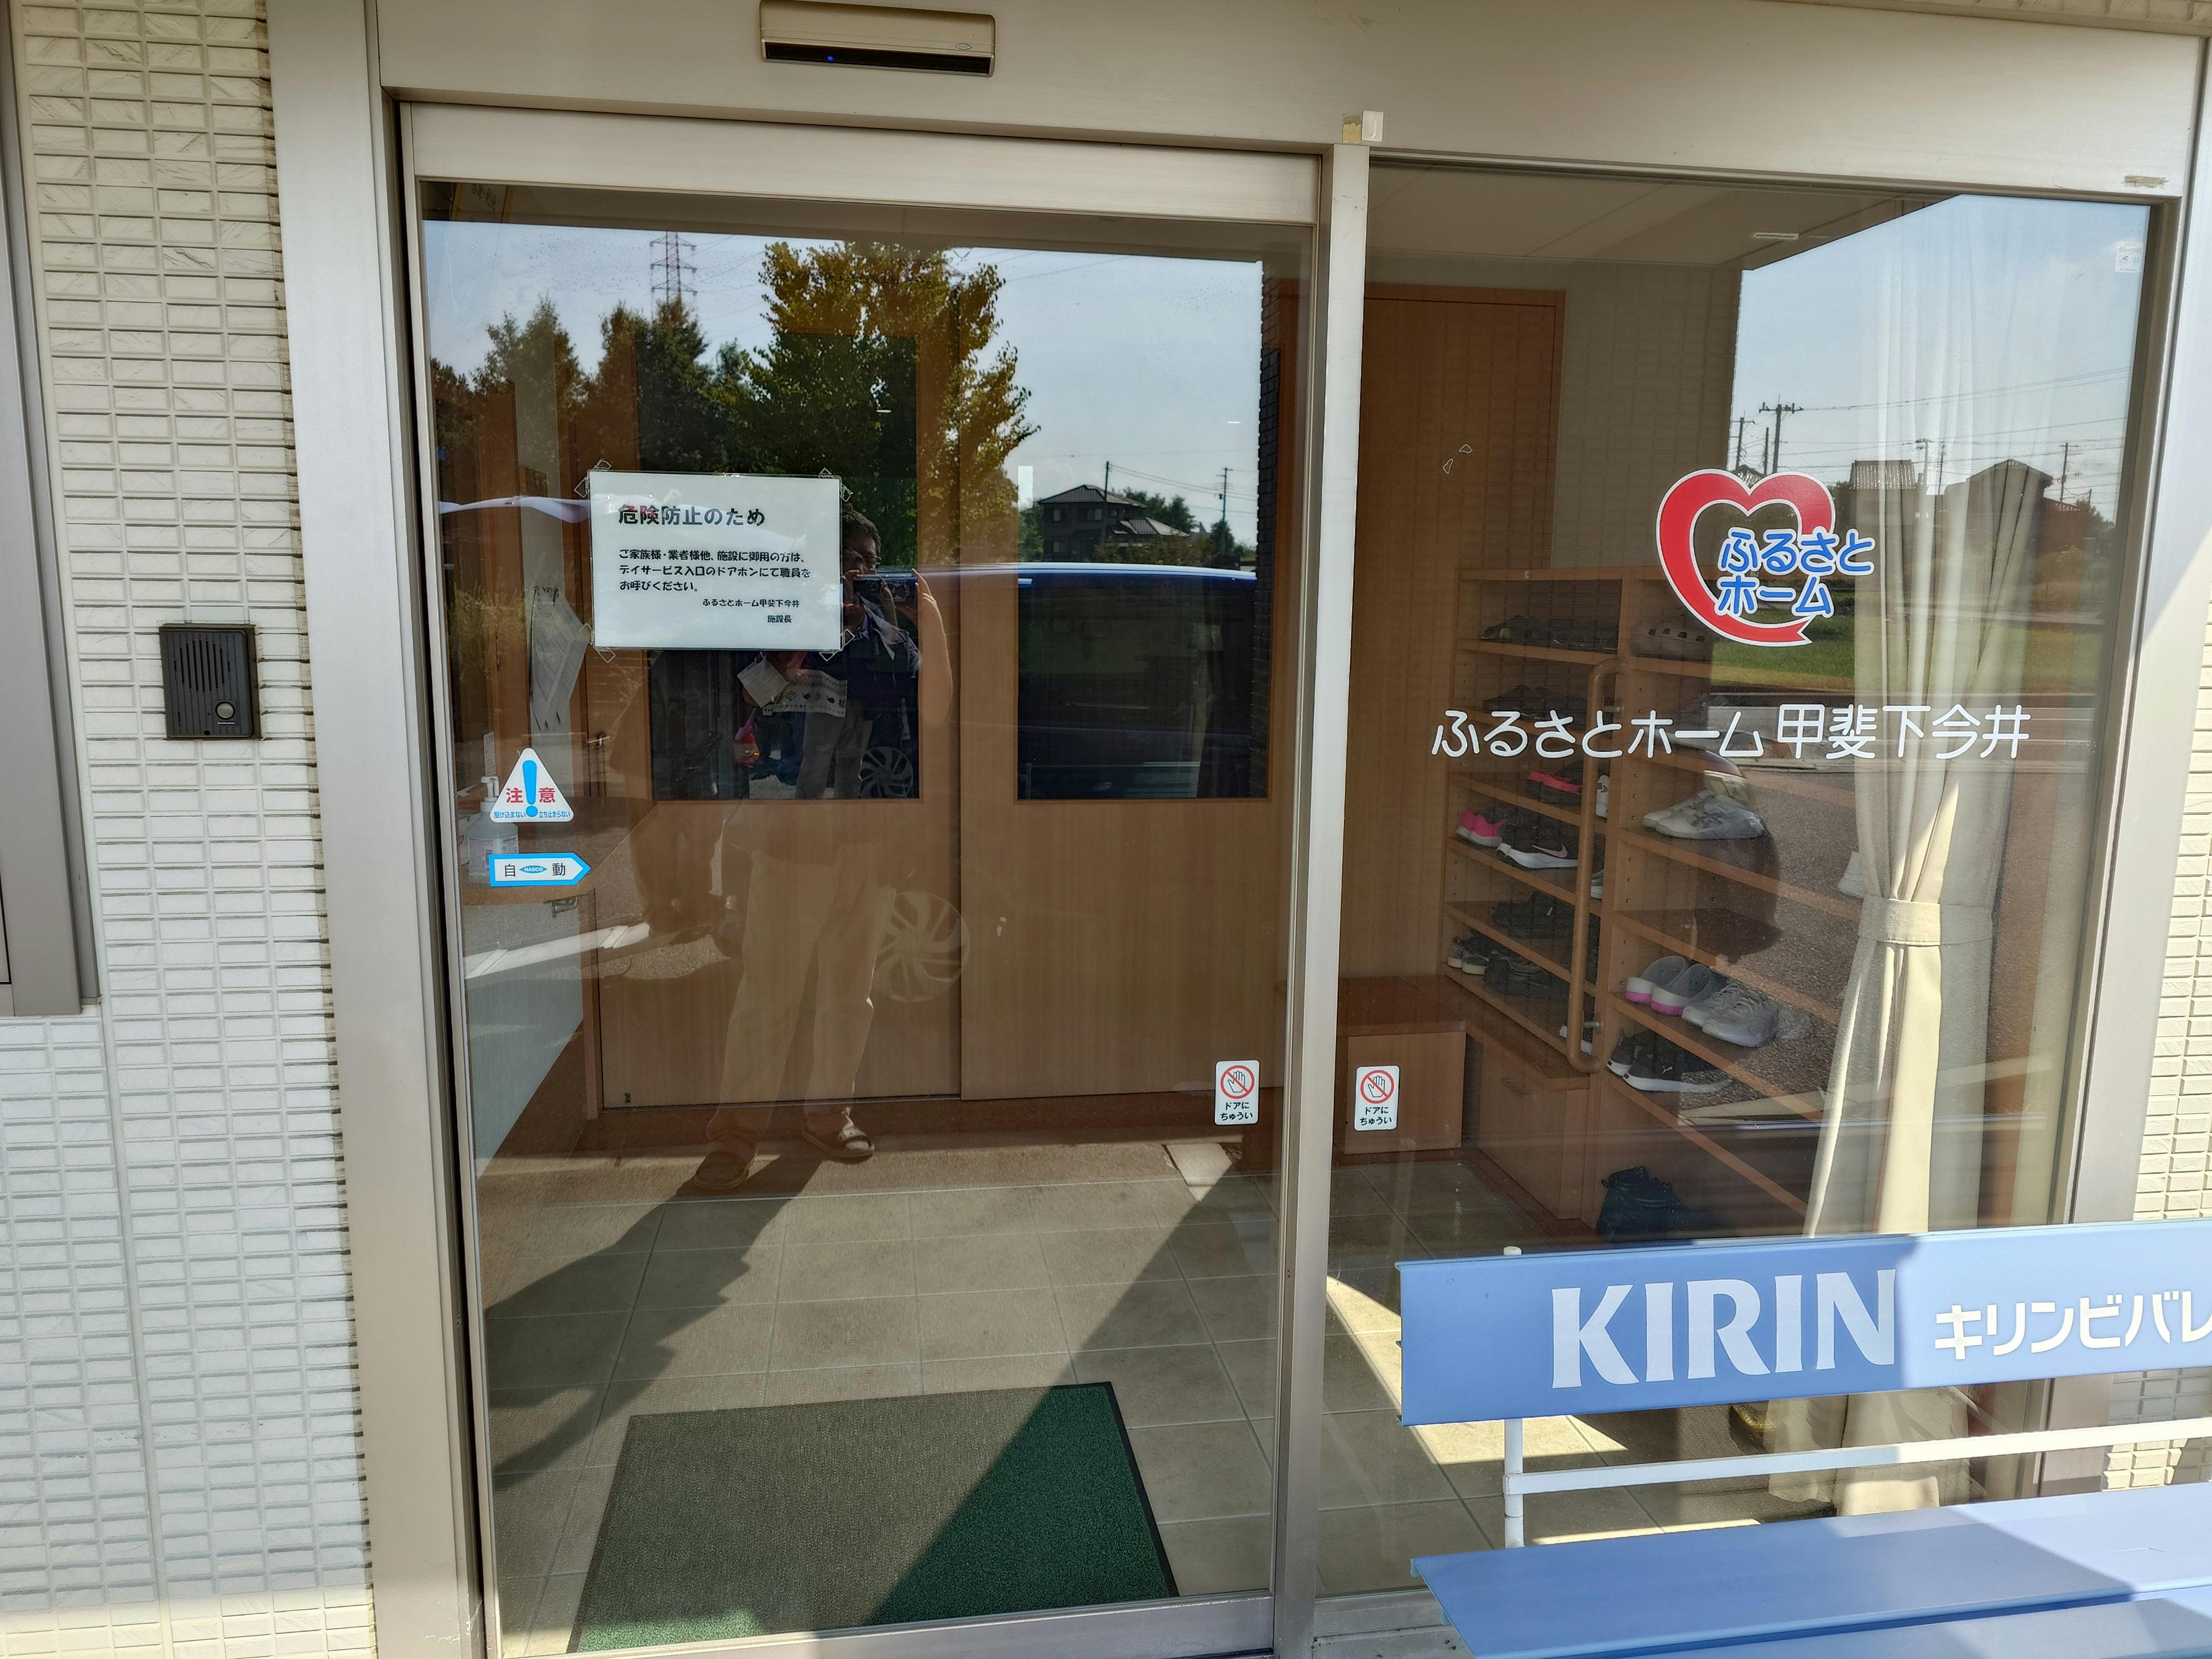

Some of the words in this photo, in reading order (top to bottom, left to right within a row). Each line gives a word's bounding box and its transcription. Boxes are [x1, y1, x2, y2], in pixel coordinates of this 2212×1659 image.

[618, 504, 766, 527] 危険防止のため
[619, 549, 805, 562] ご家族様・業者様他、施設に御用の方は、
[1720, 529, 1873, 573] ふるさと
[619, 565, 811, 578] デイサービス入口のドアホンにて職員を
[619, 580, 698, 592] お呼びください。
[1718, 575, 1832, 614] ホーム
[702, 598, 800, 608] ふるさとホーム甲斐下今井
[767, 614, 792, 623] 施設長
[1225, 1101, 1250, 1110] ドアに
[1365, 1106, 1389, 1114] ドアに
[1220, 1111, 1254, 1121] ちゅうい
[1360, 1117, 1392, 1125] ちゅうい
[1551, 1269, 1896, 1389] KIRIN
